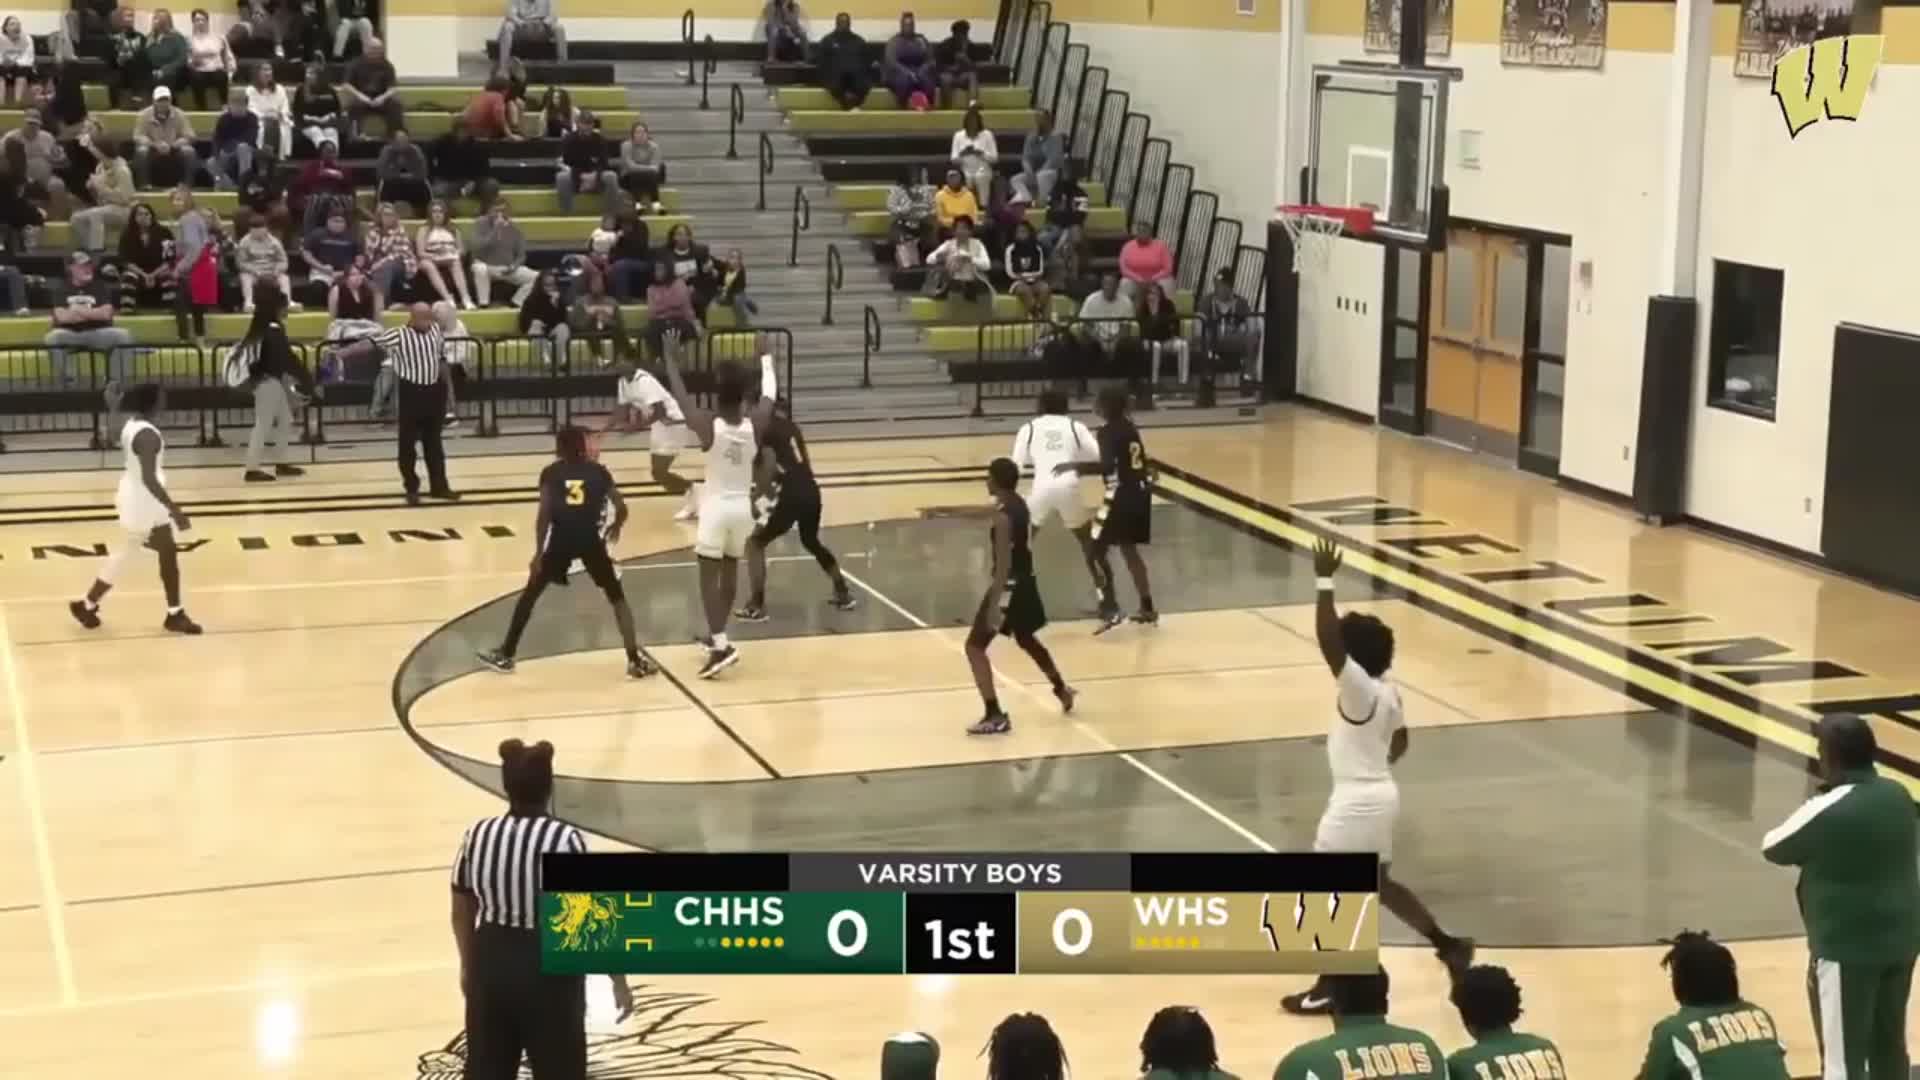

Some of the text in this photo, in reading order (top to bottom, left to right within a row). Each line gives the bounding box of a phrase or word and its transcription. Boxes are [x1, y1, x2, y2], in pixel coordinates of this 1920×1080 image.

[1128, 441, 1144, 470] 2
[565, 479, 585, 505] 3
[0, 524, 516, 561] INDIAN
[1687, 1009, 1774, 1053] LIONS
[1335, 1042, 1433, 1080] LIONS
[1475, 1047, 1560, 1080] LIONS
